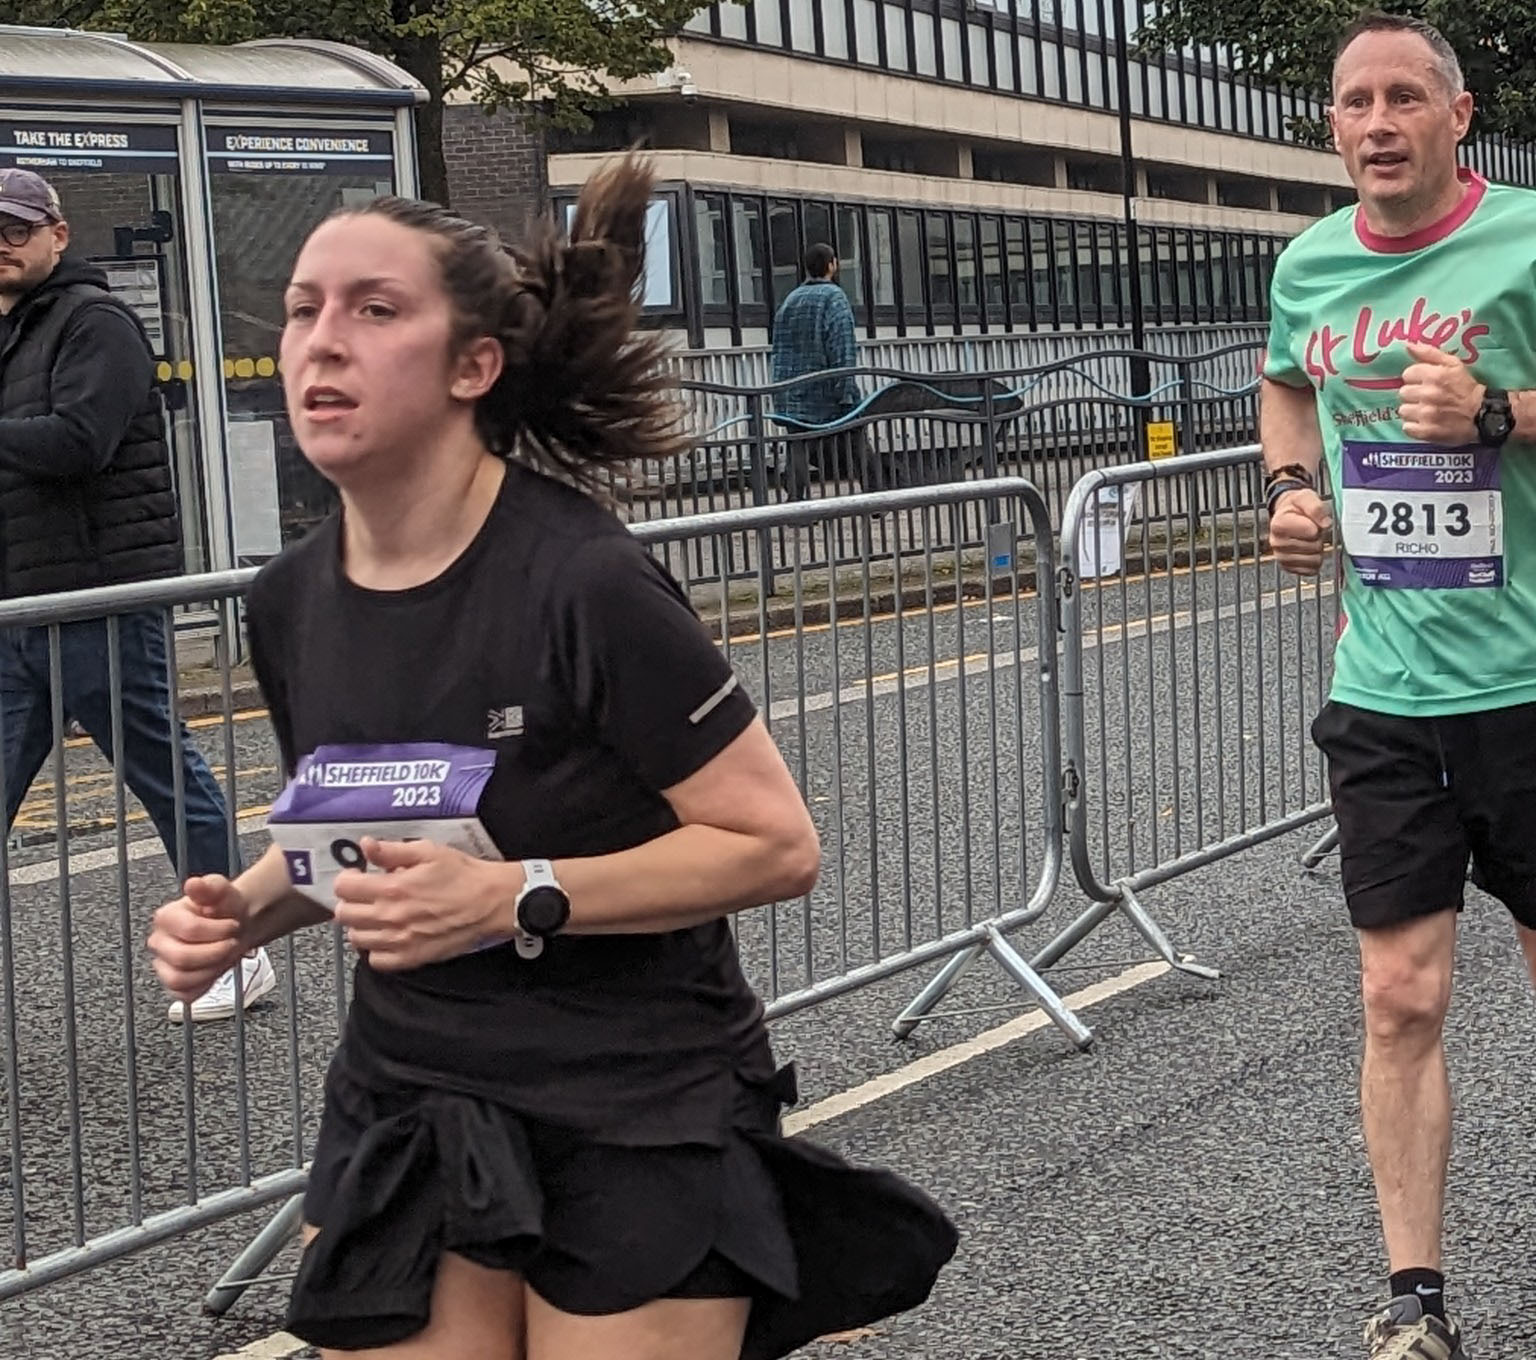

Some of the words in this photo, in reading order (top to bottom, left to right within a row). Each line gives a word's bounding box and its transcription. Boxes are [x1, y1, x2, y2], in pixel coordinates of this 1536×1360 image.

[13, 130, 46, 146] TAKE
[47, 131, 72, 147] THE
[74, 131, 128, 148] EXPRESS
[225, 135, 294, 151] EXPERIENCE
[295, 137, 369, 152] CONVENIENCE
[1305, 324, 1347, 392] St
[1353, 297, 1490, 365] Luke's
[1381, 455, 1446, 468] SHEFFIELD
[1448, 455, 1472, 467] 10K
[1434, 470, 1473, 483] 2023
[1367, 501, 1472, 537] 2813
[1395, 542, 1440, 555] RICHO
[327, 764, 409, 784] SHEFFIELD
[413, 762, 445, 781] 10K
[390, 786, 442, 807] 2023
